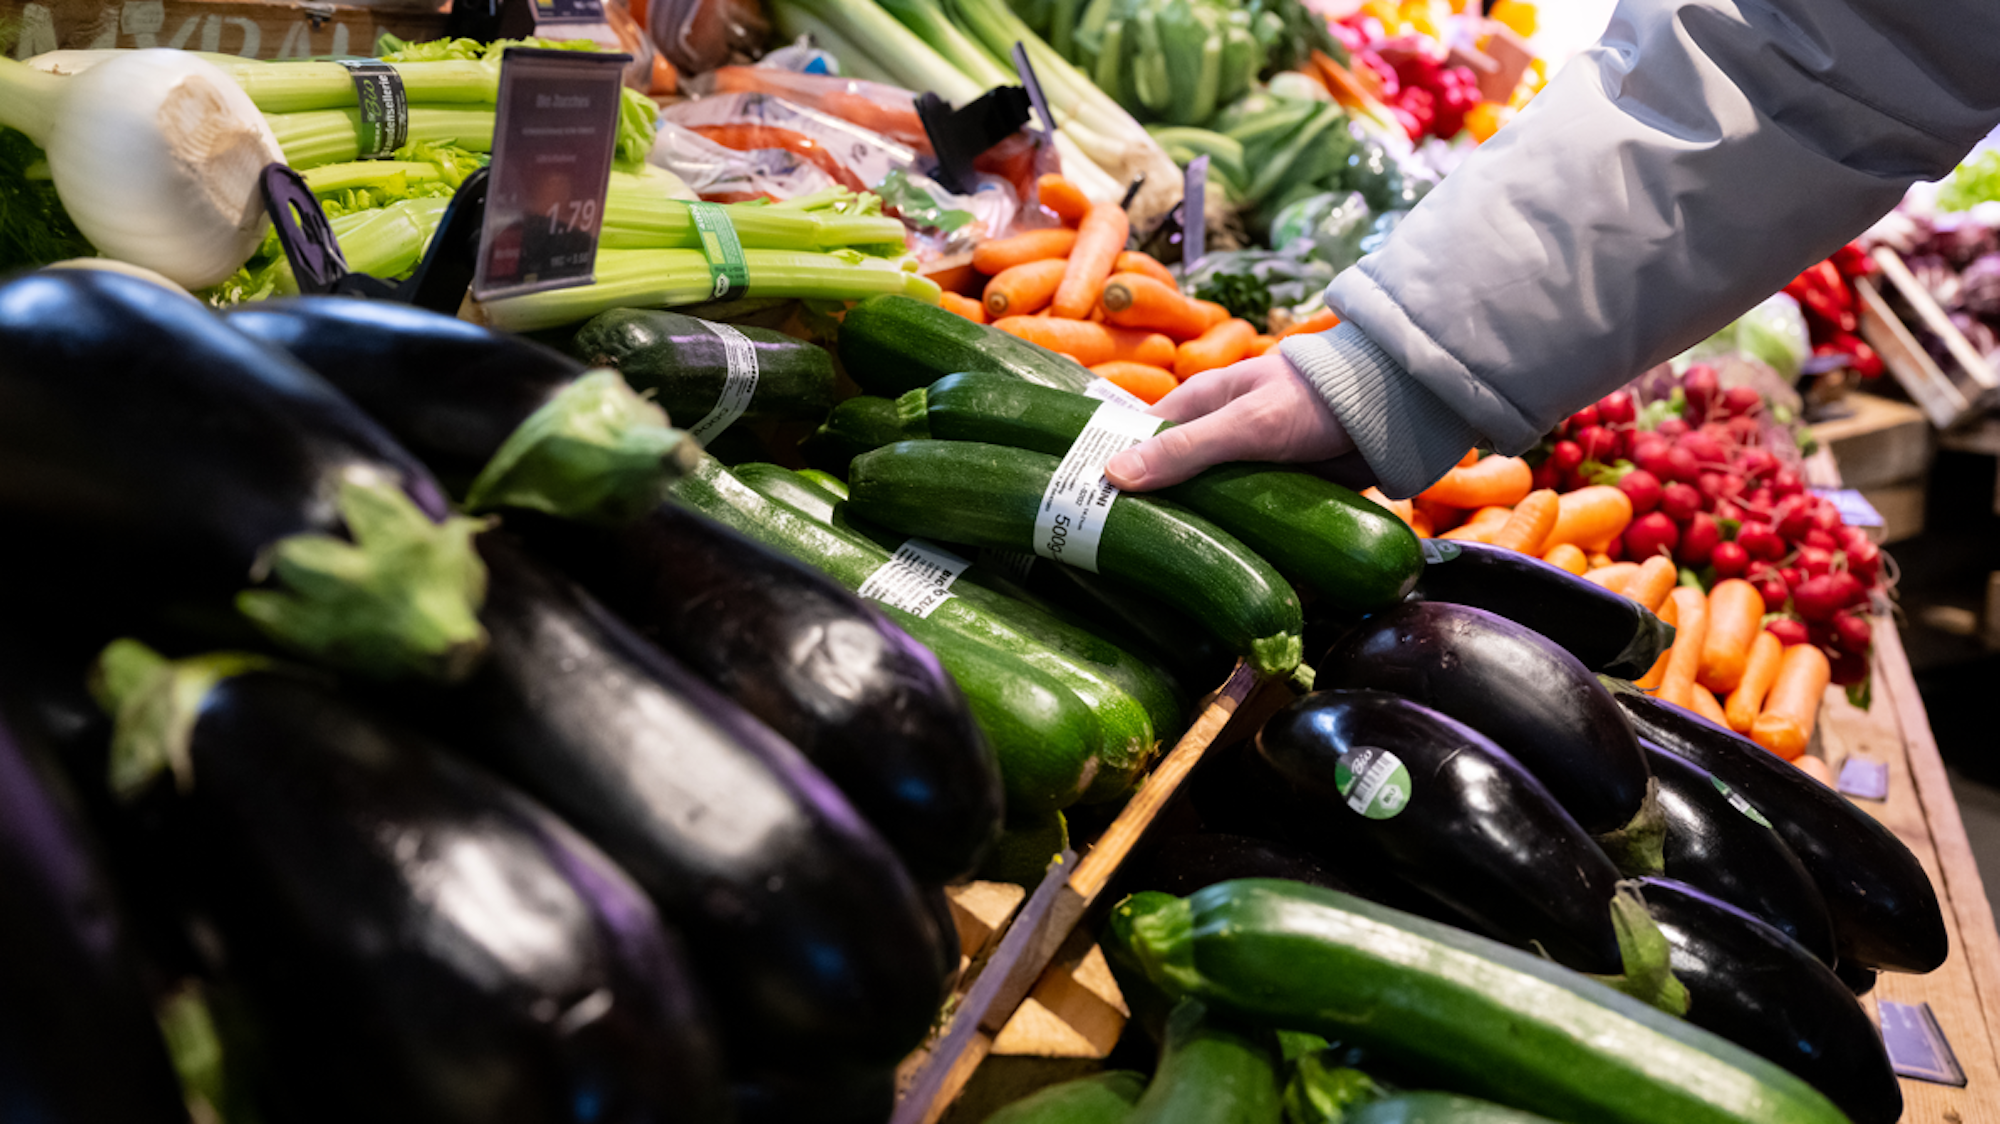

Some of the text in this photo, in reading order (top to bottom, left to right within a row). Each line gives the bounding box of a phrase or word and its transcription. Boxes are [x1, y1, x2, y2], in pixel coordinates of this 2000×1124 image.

[547, 198, 597, 235] 1.79
[1047, 514, 1071, 553] 500g
[1351, 749, 1374, 776] Bio
